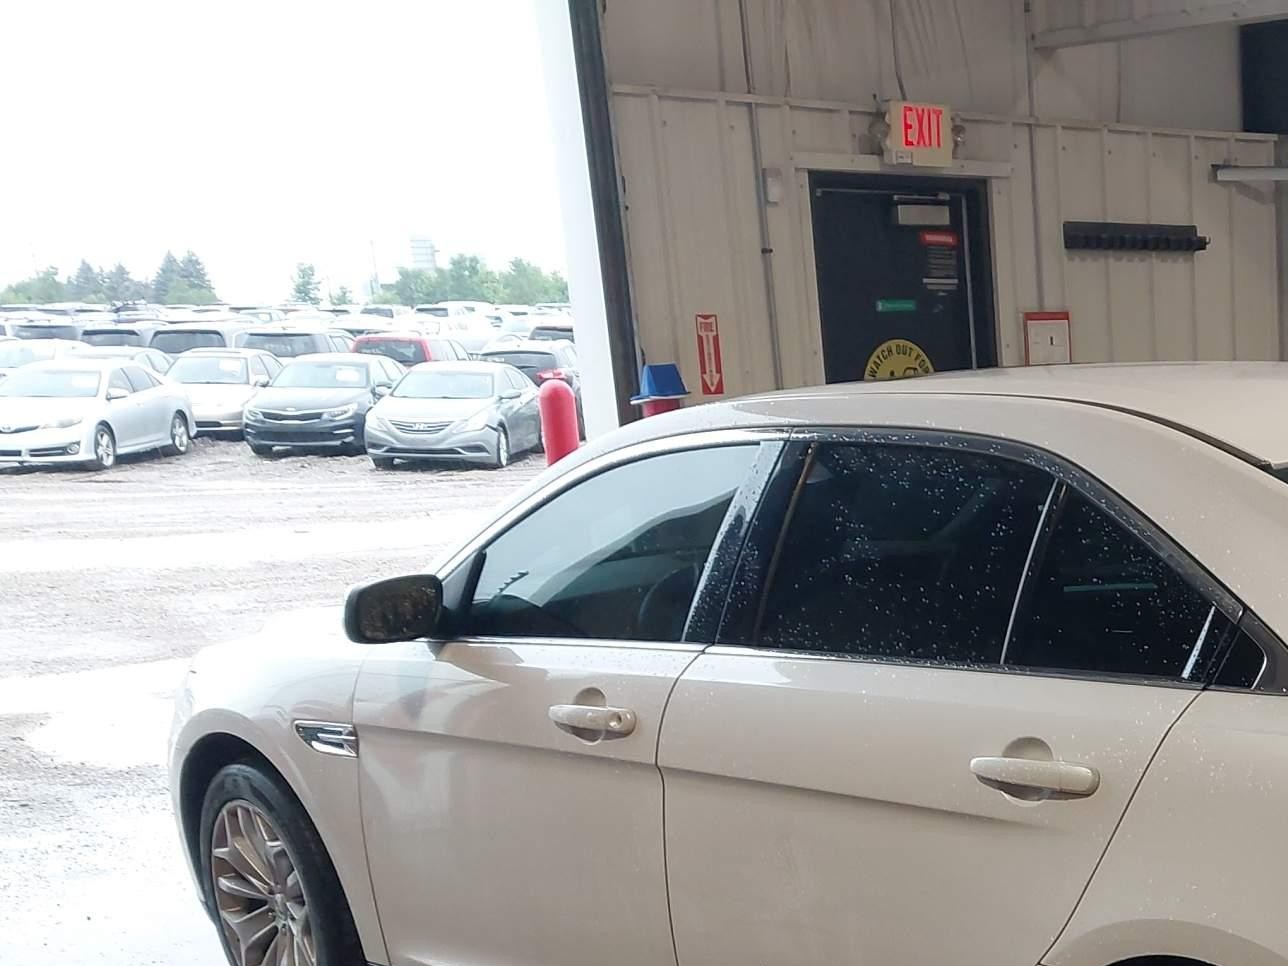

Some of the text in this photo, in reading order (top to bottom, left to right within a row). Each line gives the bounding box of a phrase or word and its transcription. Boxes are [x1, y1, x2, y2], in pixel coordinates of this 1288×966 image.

[903, 105, 943, 149] EXIT
[868, 345, 894, 378] WATCH
[895, 343, 913, 357] OUT
